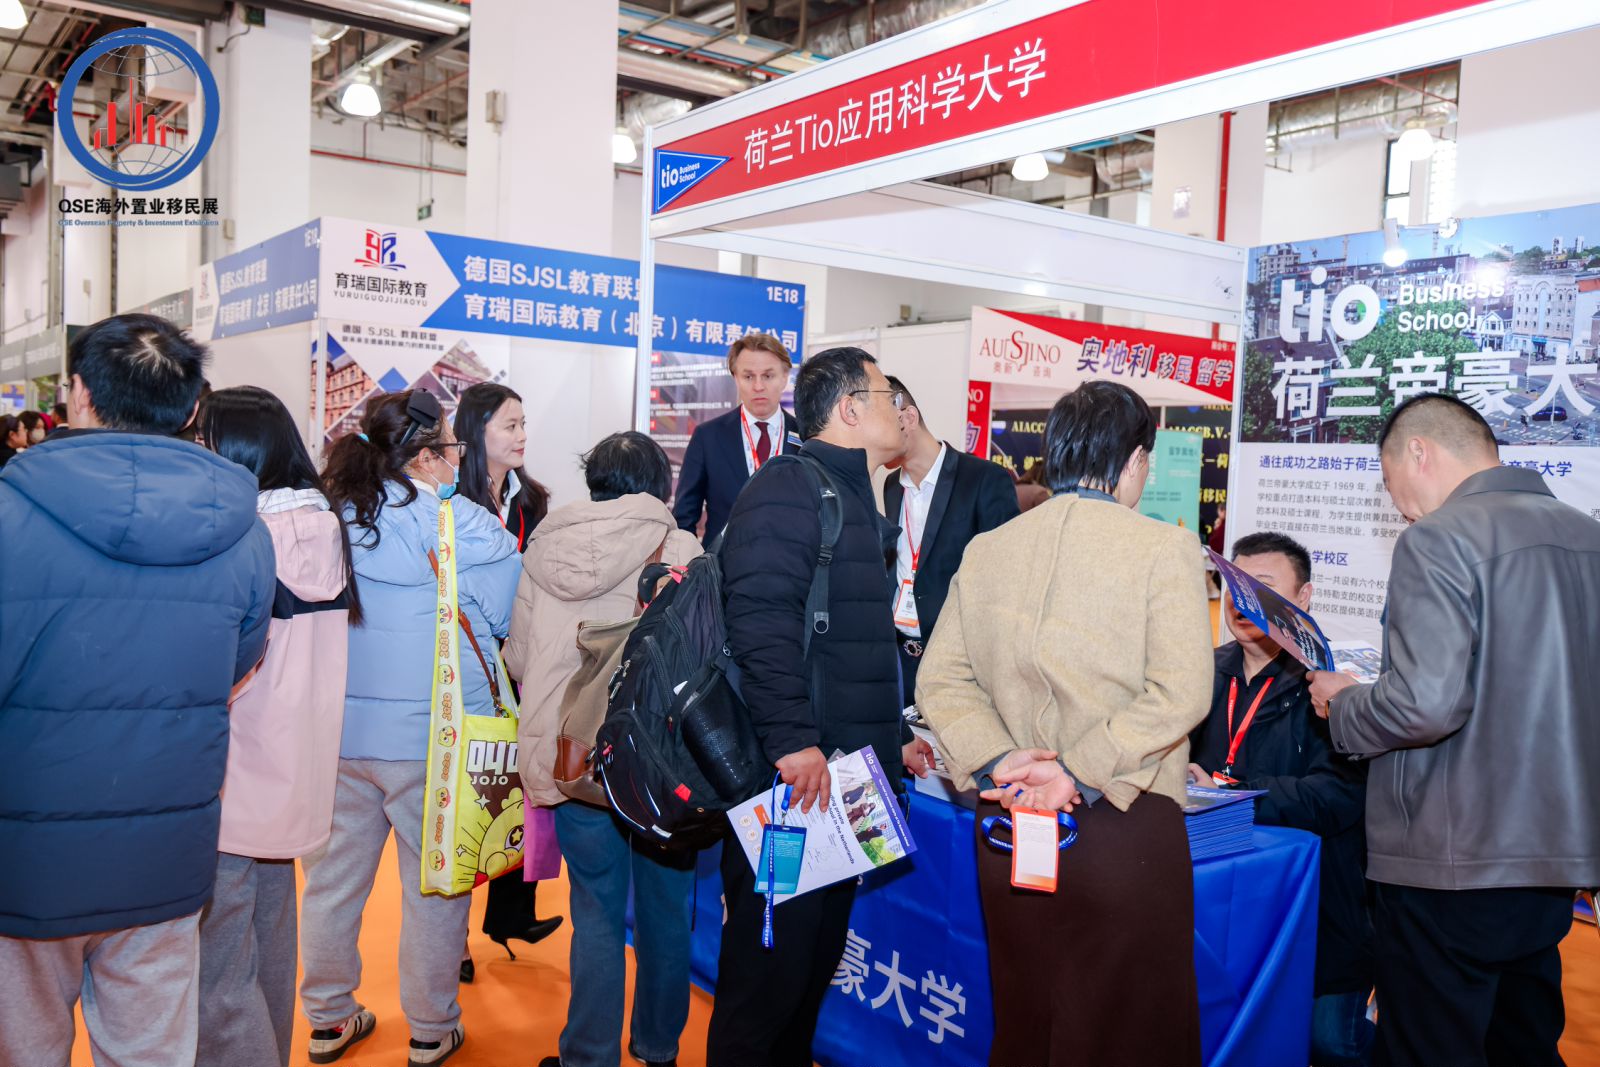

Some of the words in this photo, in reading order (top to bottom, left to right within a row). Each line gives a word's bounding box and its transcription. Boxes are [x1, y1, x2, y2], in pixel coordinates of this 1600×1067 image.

[744, 37, 1047, 174] 荷兰Tio应用科学大学
[661, 164, 679, 188] tio
[679, 162, 700, 175] Business
[679, 170, 696, 183] School
[335, 272, 428, 298] 育瑞国际教育
[334, 290, 428, 307] YURUIGUOJIJIAOYU
[766, 286, 799, 304] 1E18
[1280, 266, 1381, 343] tio
[1398, 277, 1505, 306] Business
[1398, 307, 1477, 334] School
[368, 327, 397, 338] SJSL
[1077, 336, 1155, 378] 奥地利
[1156, 352, 1194, 384] 移民
[1196, 357, 1233, 387] 留学
[1271, 345, 1598, 420] 荷兰帝豪大
[1259, 455, 1380, 472] 通往成功之路始于荷兰
[1334, 482, 1355, 491] 1969
[1312, 550, 1348, 566] 学校区
[1312, 573, 1389, 590] 兰一共设有六个校
[1312, 587, 1384, 605] 乌特勒支的校区支
[865, 753, 874, 765] tio
[471, 776, 509, 785] JOJO
[834, 806, 844, 825] private
[840, 834, 855, 864] Netherlands
